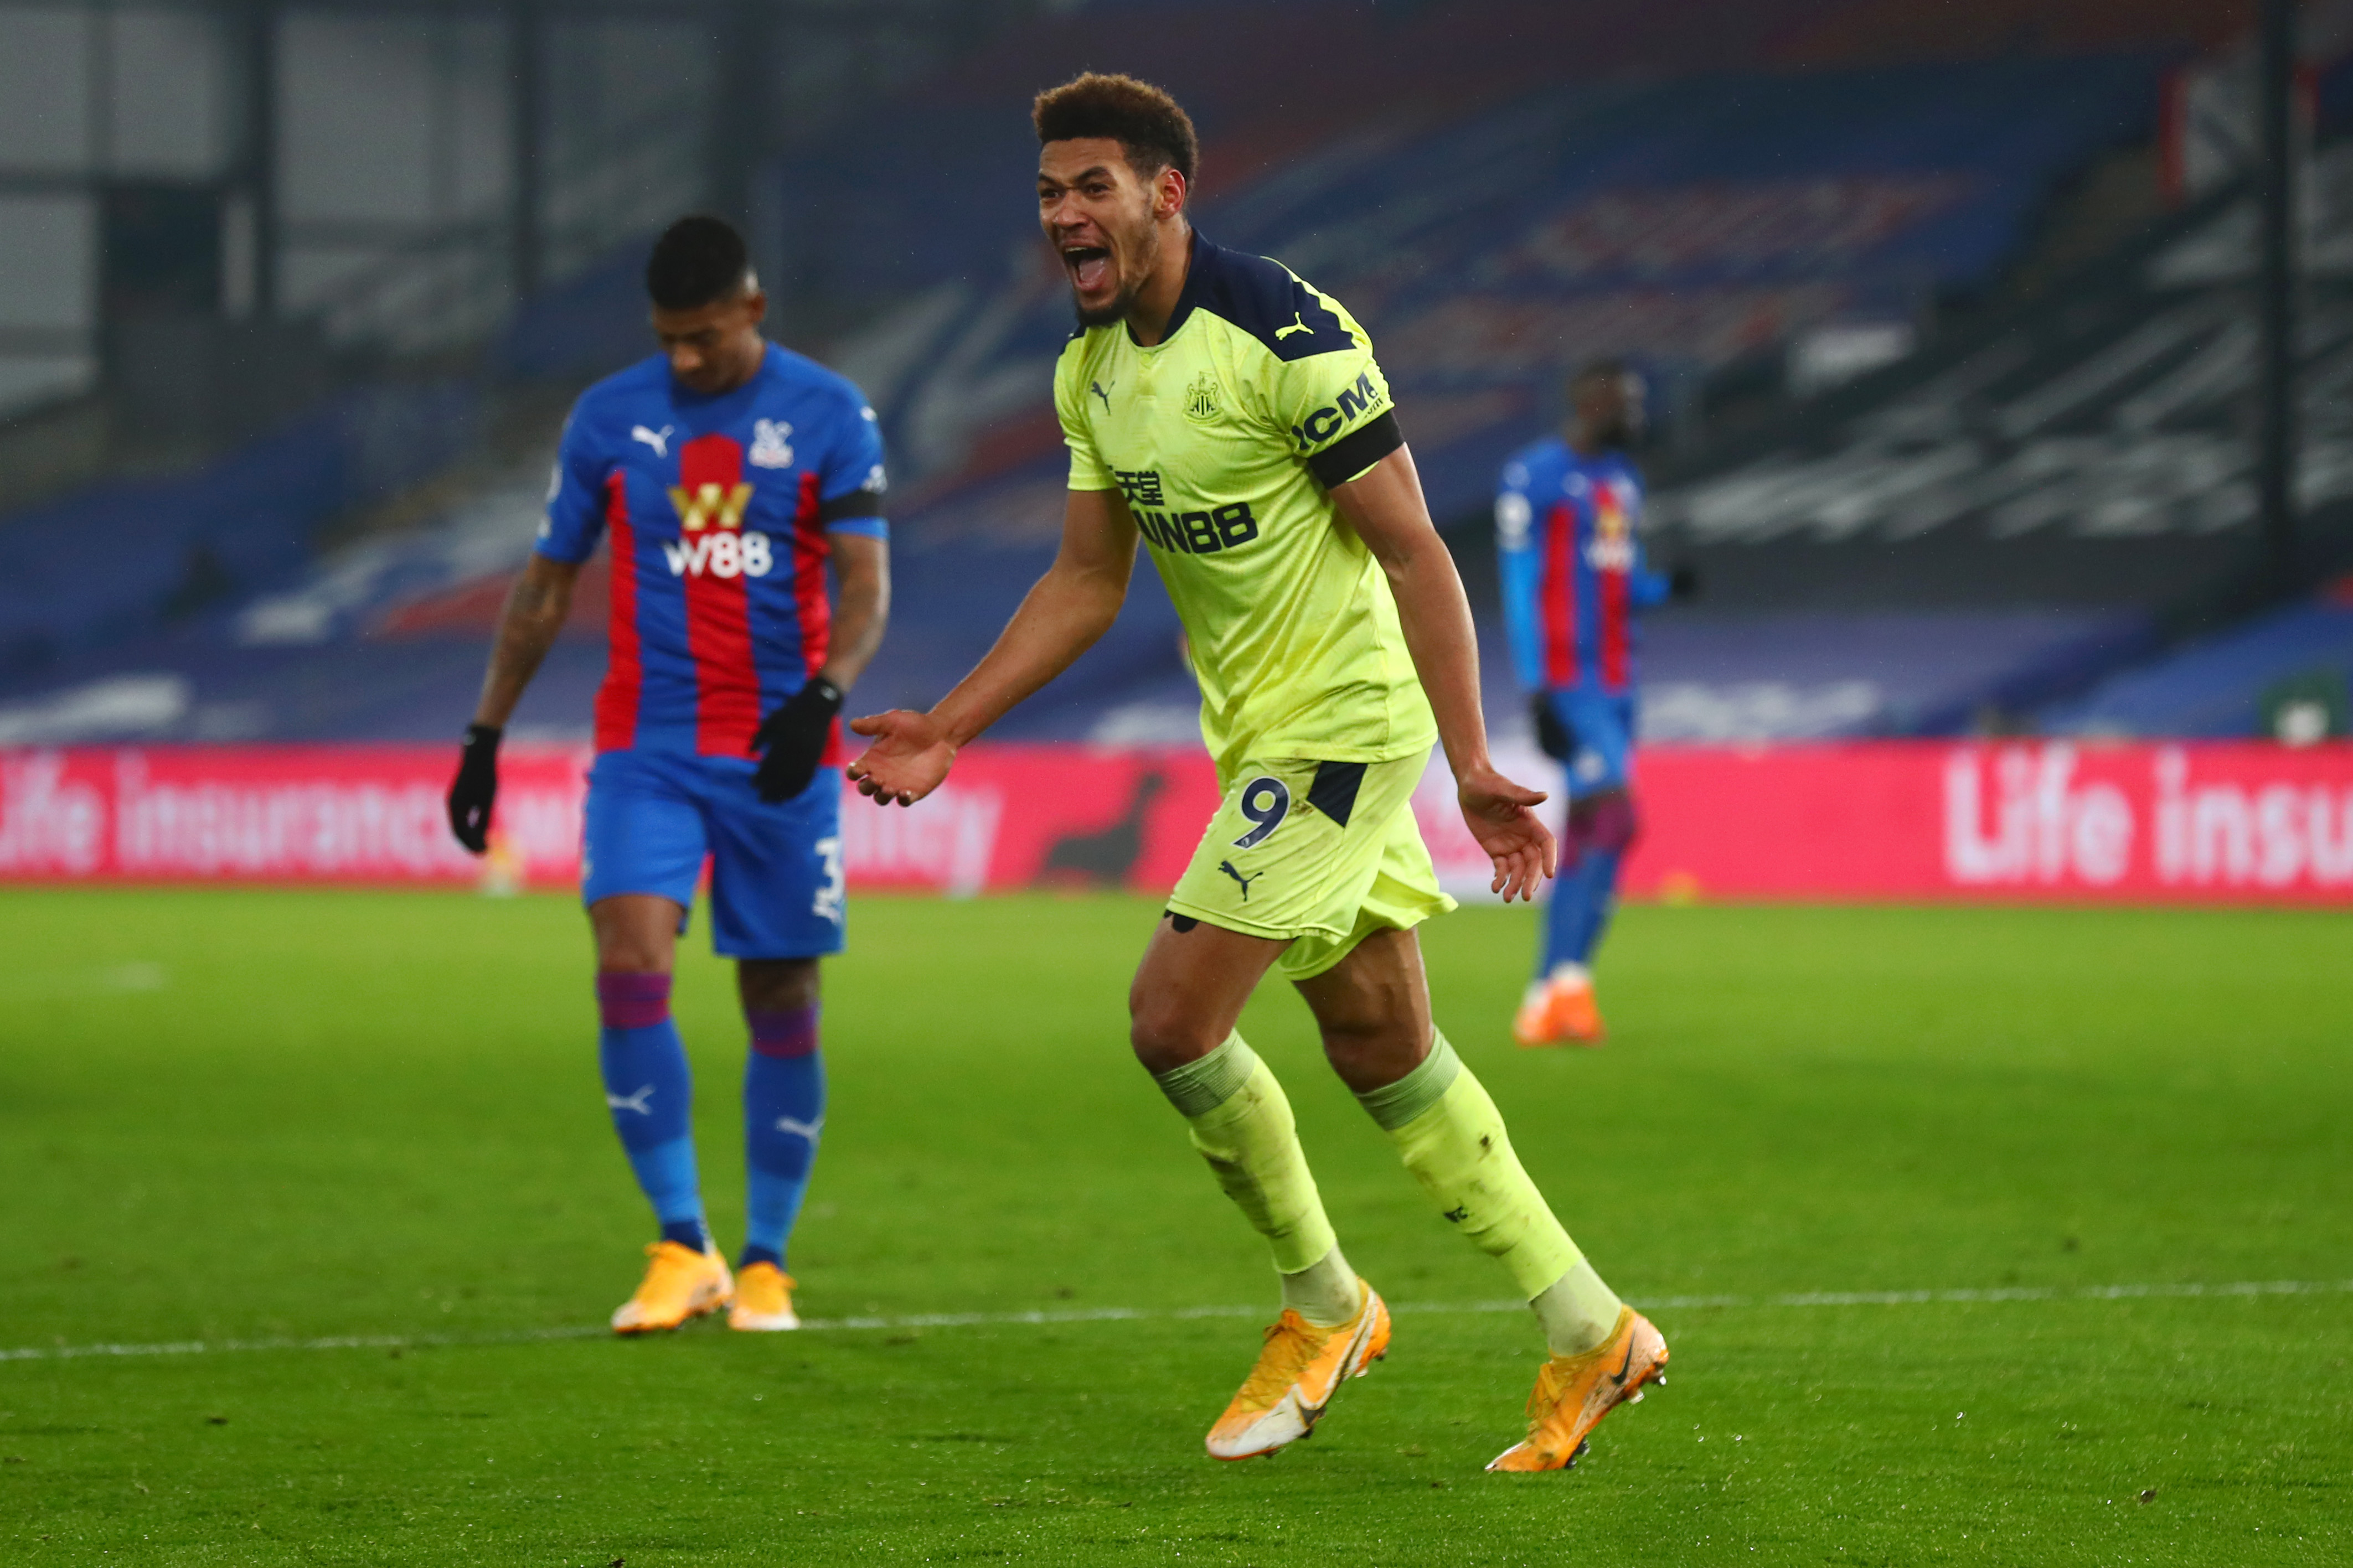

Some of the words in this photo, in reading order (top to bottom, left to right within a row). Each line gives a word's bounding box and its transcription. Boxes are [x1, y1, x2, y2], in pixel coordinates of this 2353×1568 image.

[663, 531, 773, 578] W88
[1132, 501, 1258, 554] UN88
[1231, 776, 1291, 849] 9
[1944, 742, 2135, 882] Life
